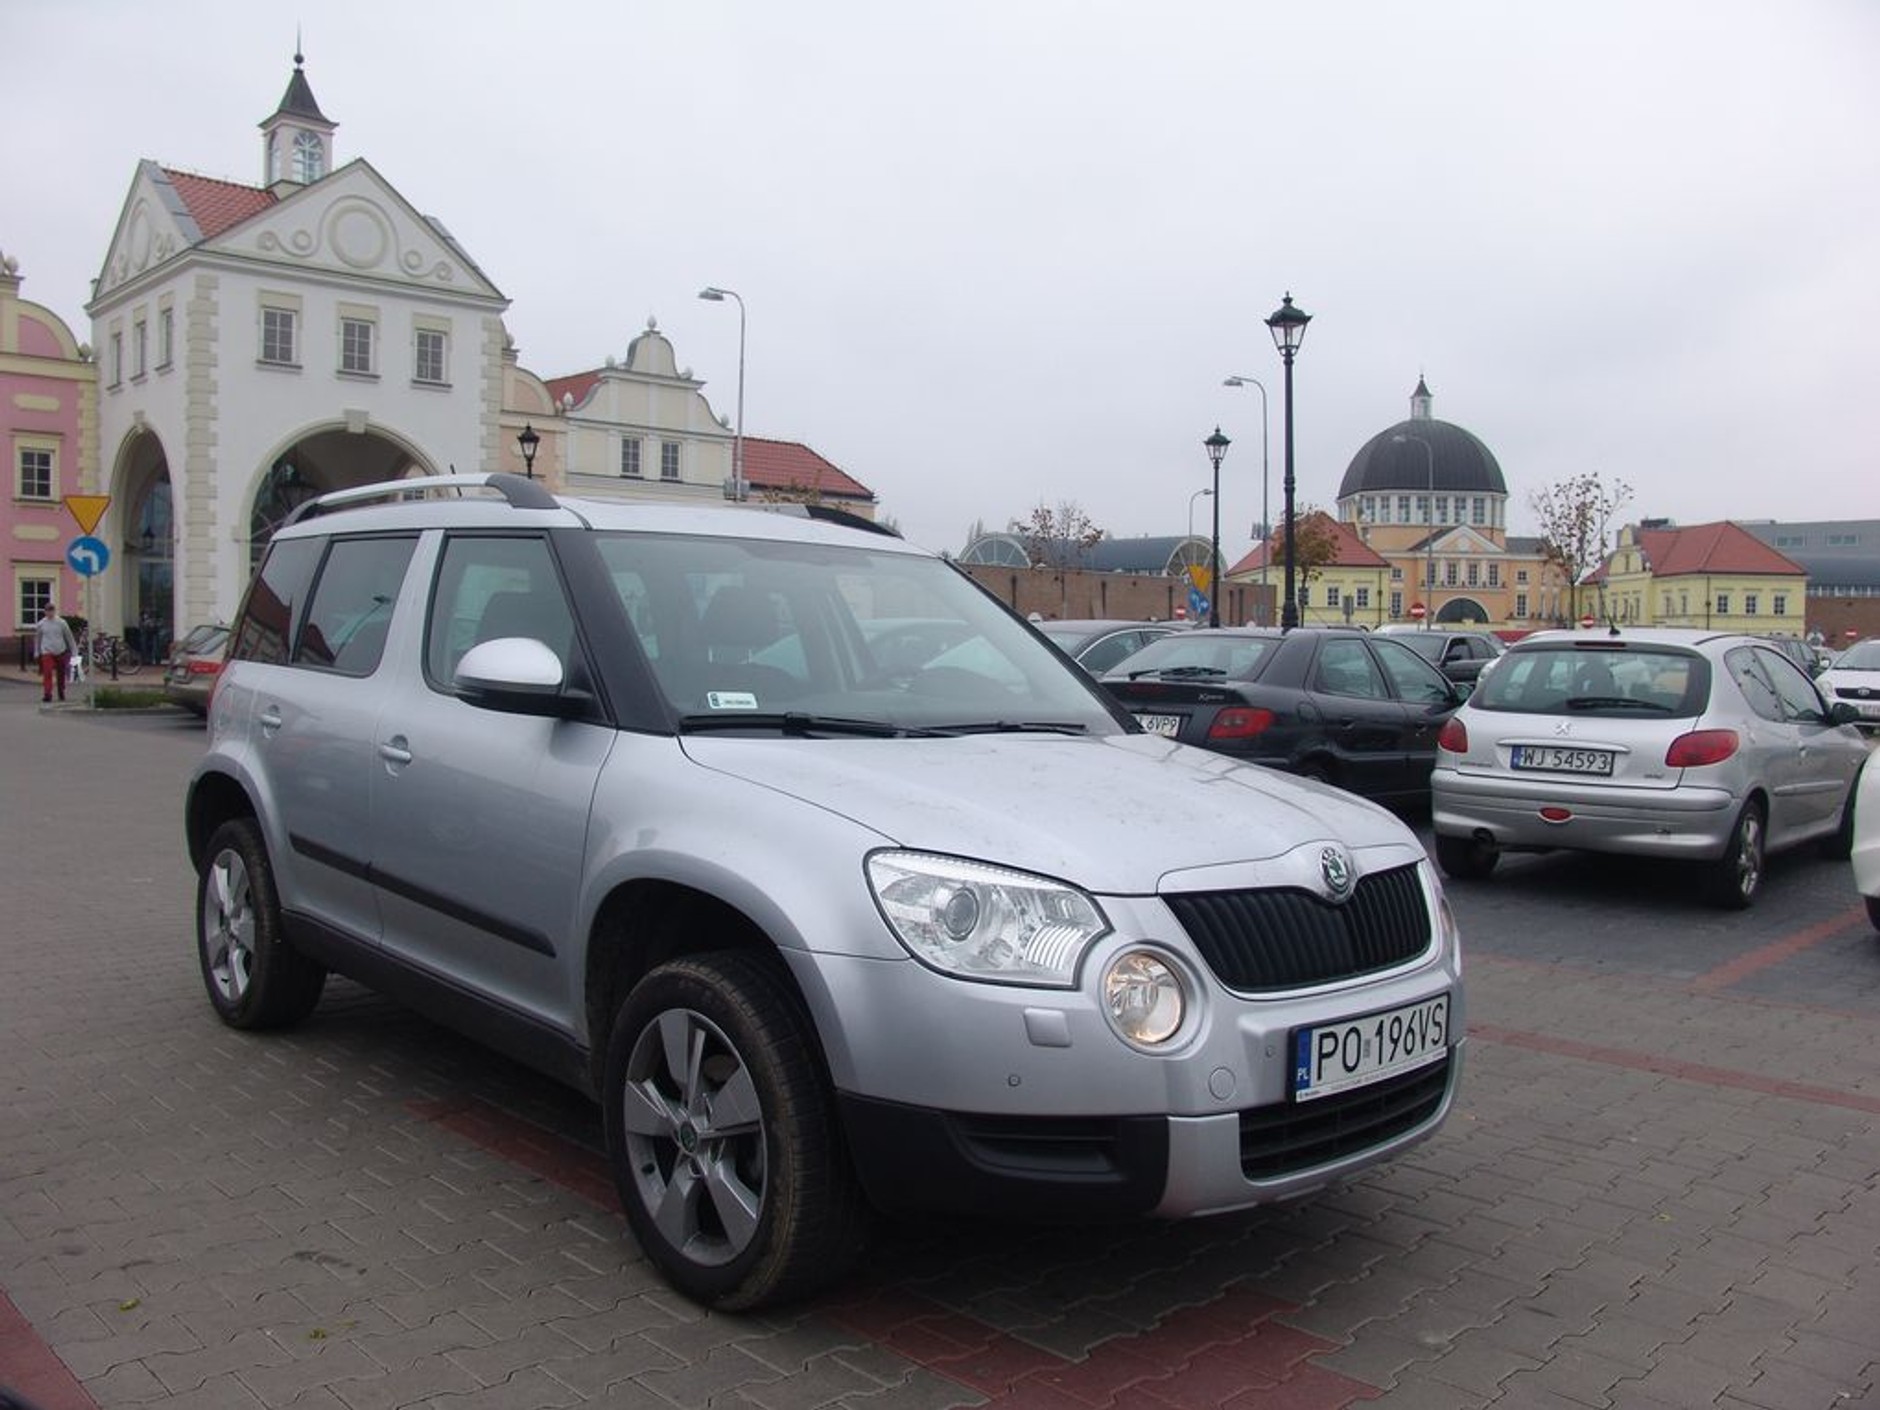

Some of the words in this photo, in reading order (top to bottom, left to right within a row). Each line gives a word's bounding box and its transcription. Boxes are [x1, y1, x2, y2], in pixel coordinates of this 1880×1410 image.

[1523, 748, 1546, 766] WJ
[1552, 750, 1609, 770] 54593
[1316, 1026, 1362, 1081] PO
[1375, 1003, 1443, 1065] 196VS
